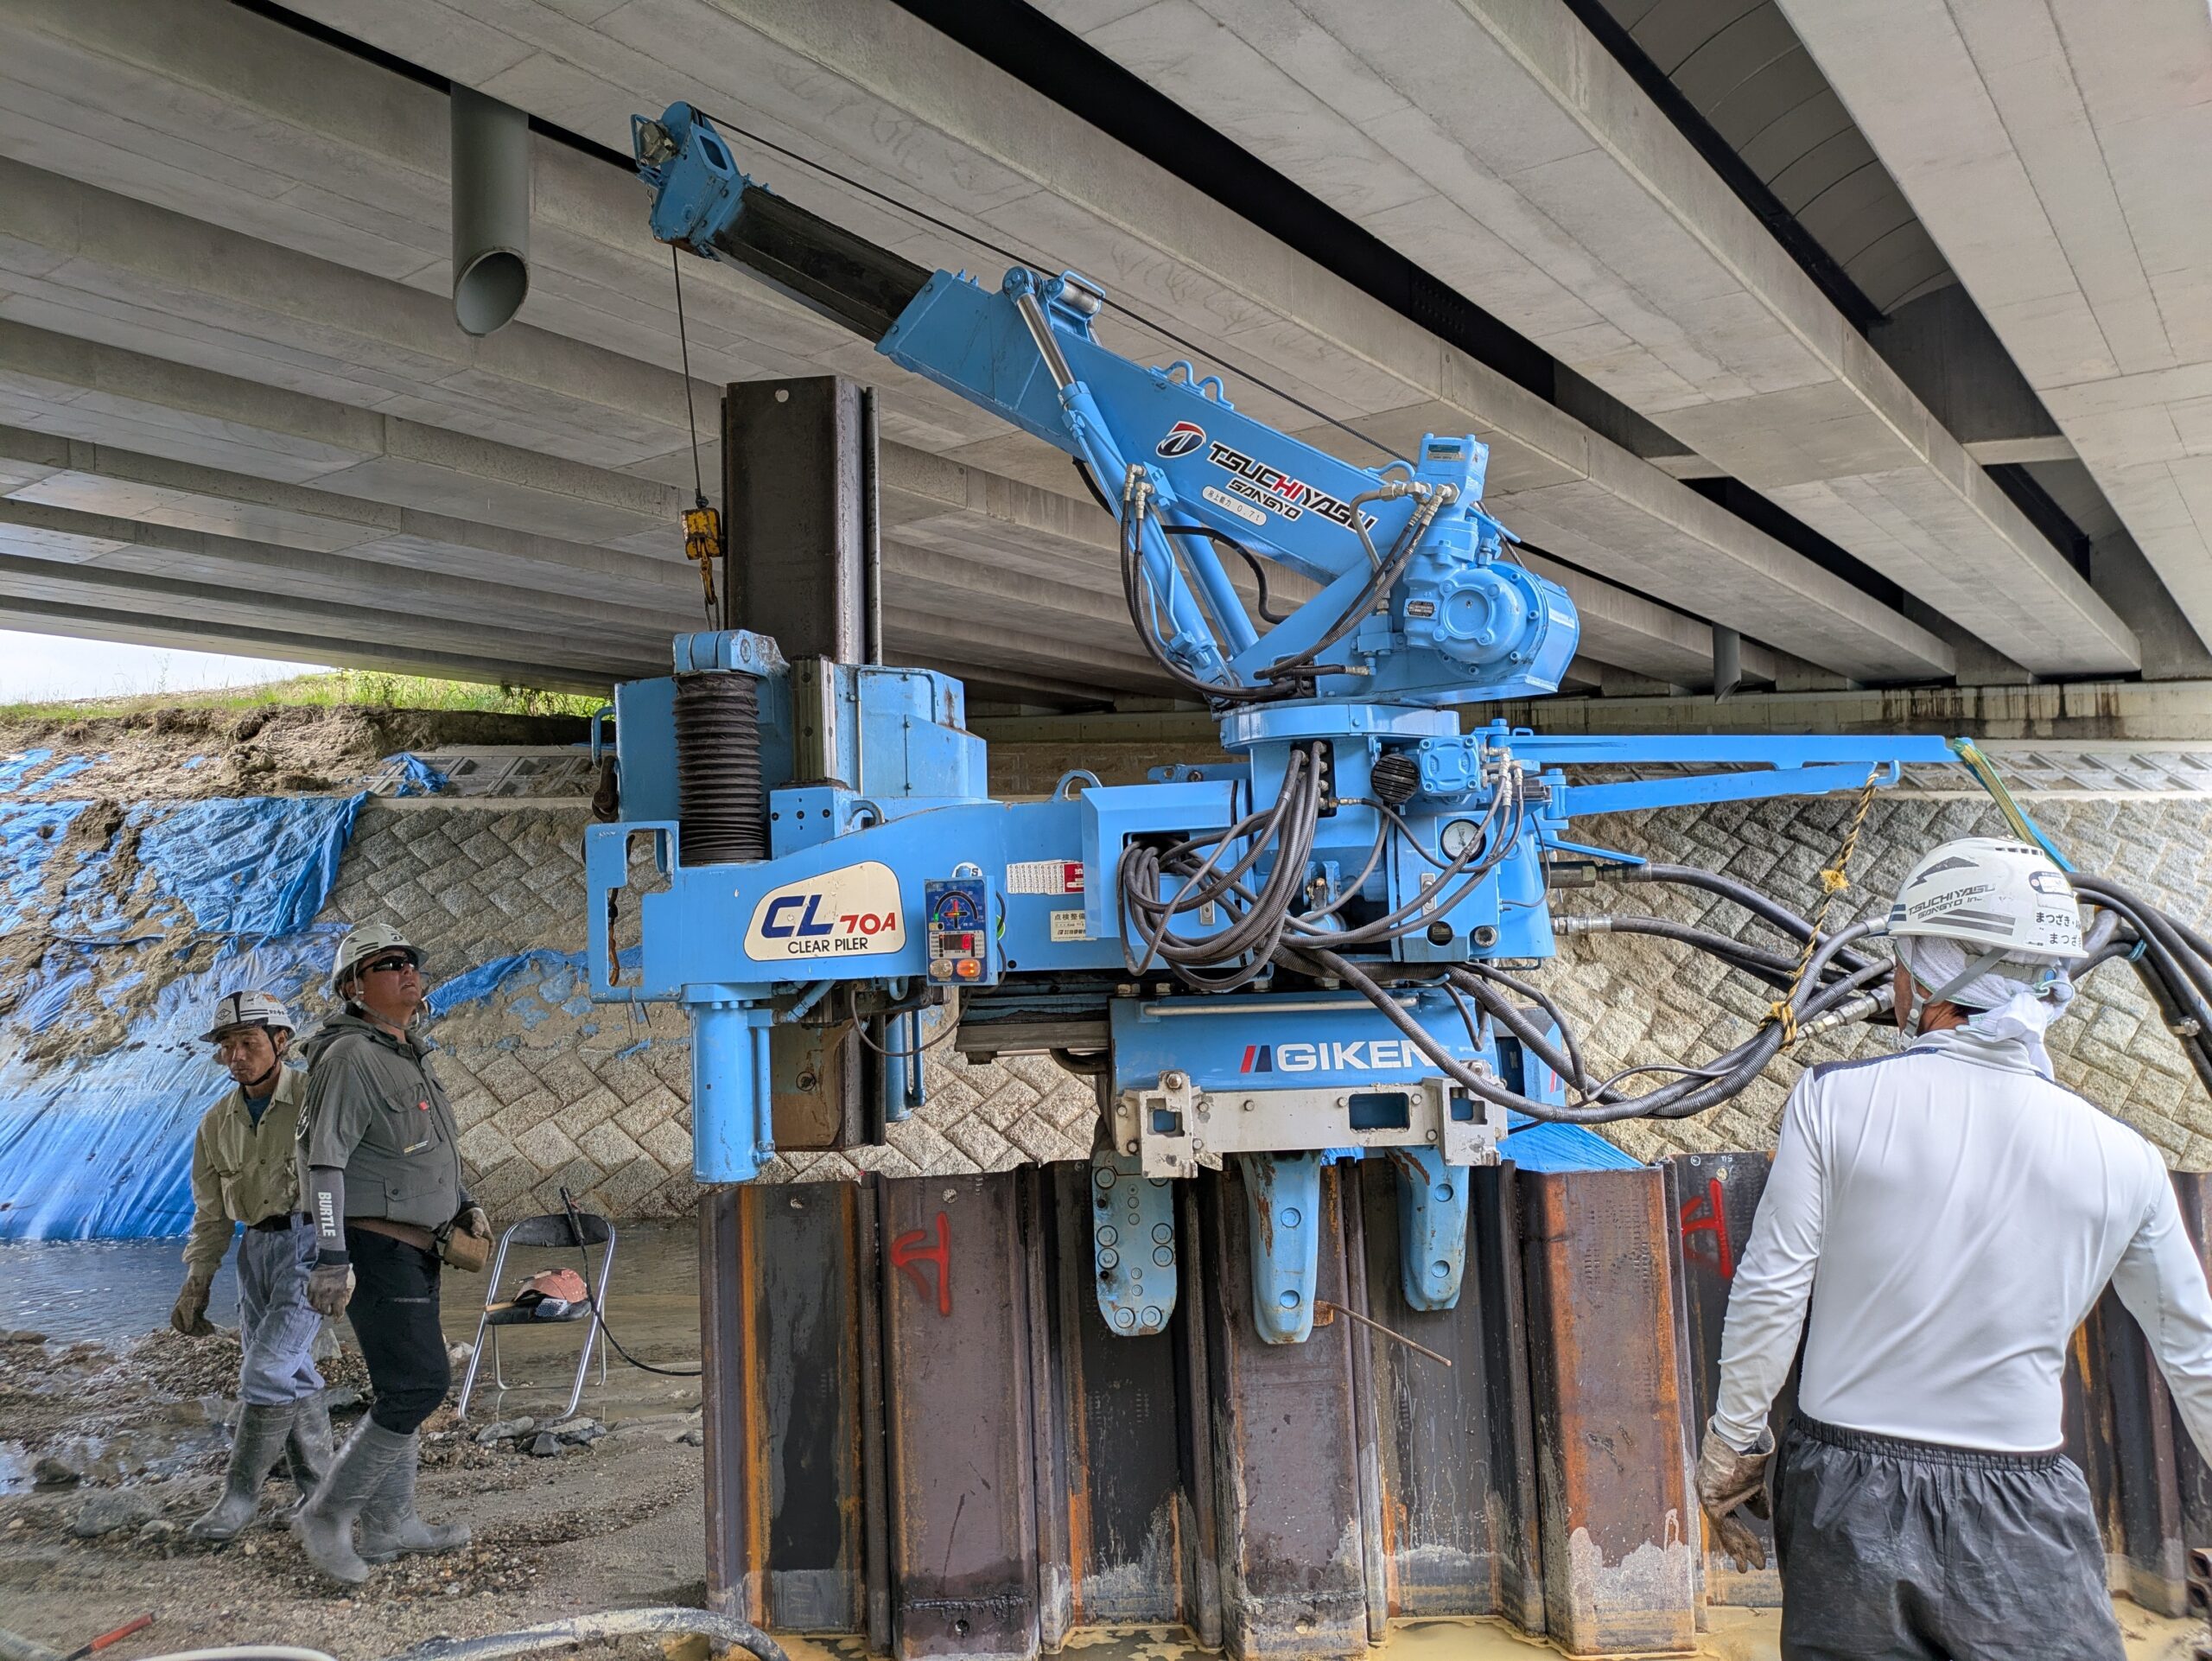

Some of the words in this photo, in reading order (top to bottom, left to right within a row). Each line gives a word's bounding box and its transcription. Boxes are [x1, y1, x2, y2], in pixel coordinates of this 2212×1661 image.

[1228, 478, 1301, 519] SANGYO
[760, 894, 835, 939] CL
[839, 912, 897, 935] 70A
[1917, 898, 1963, 920] SANGYO
[787, 939, 830, 954] CLEAR
[835, 937, 868, 951] PILER
[1276, 1040, 1437, 1072] GIKEN
[317, 1192, 336, 1237] BURTLE
